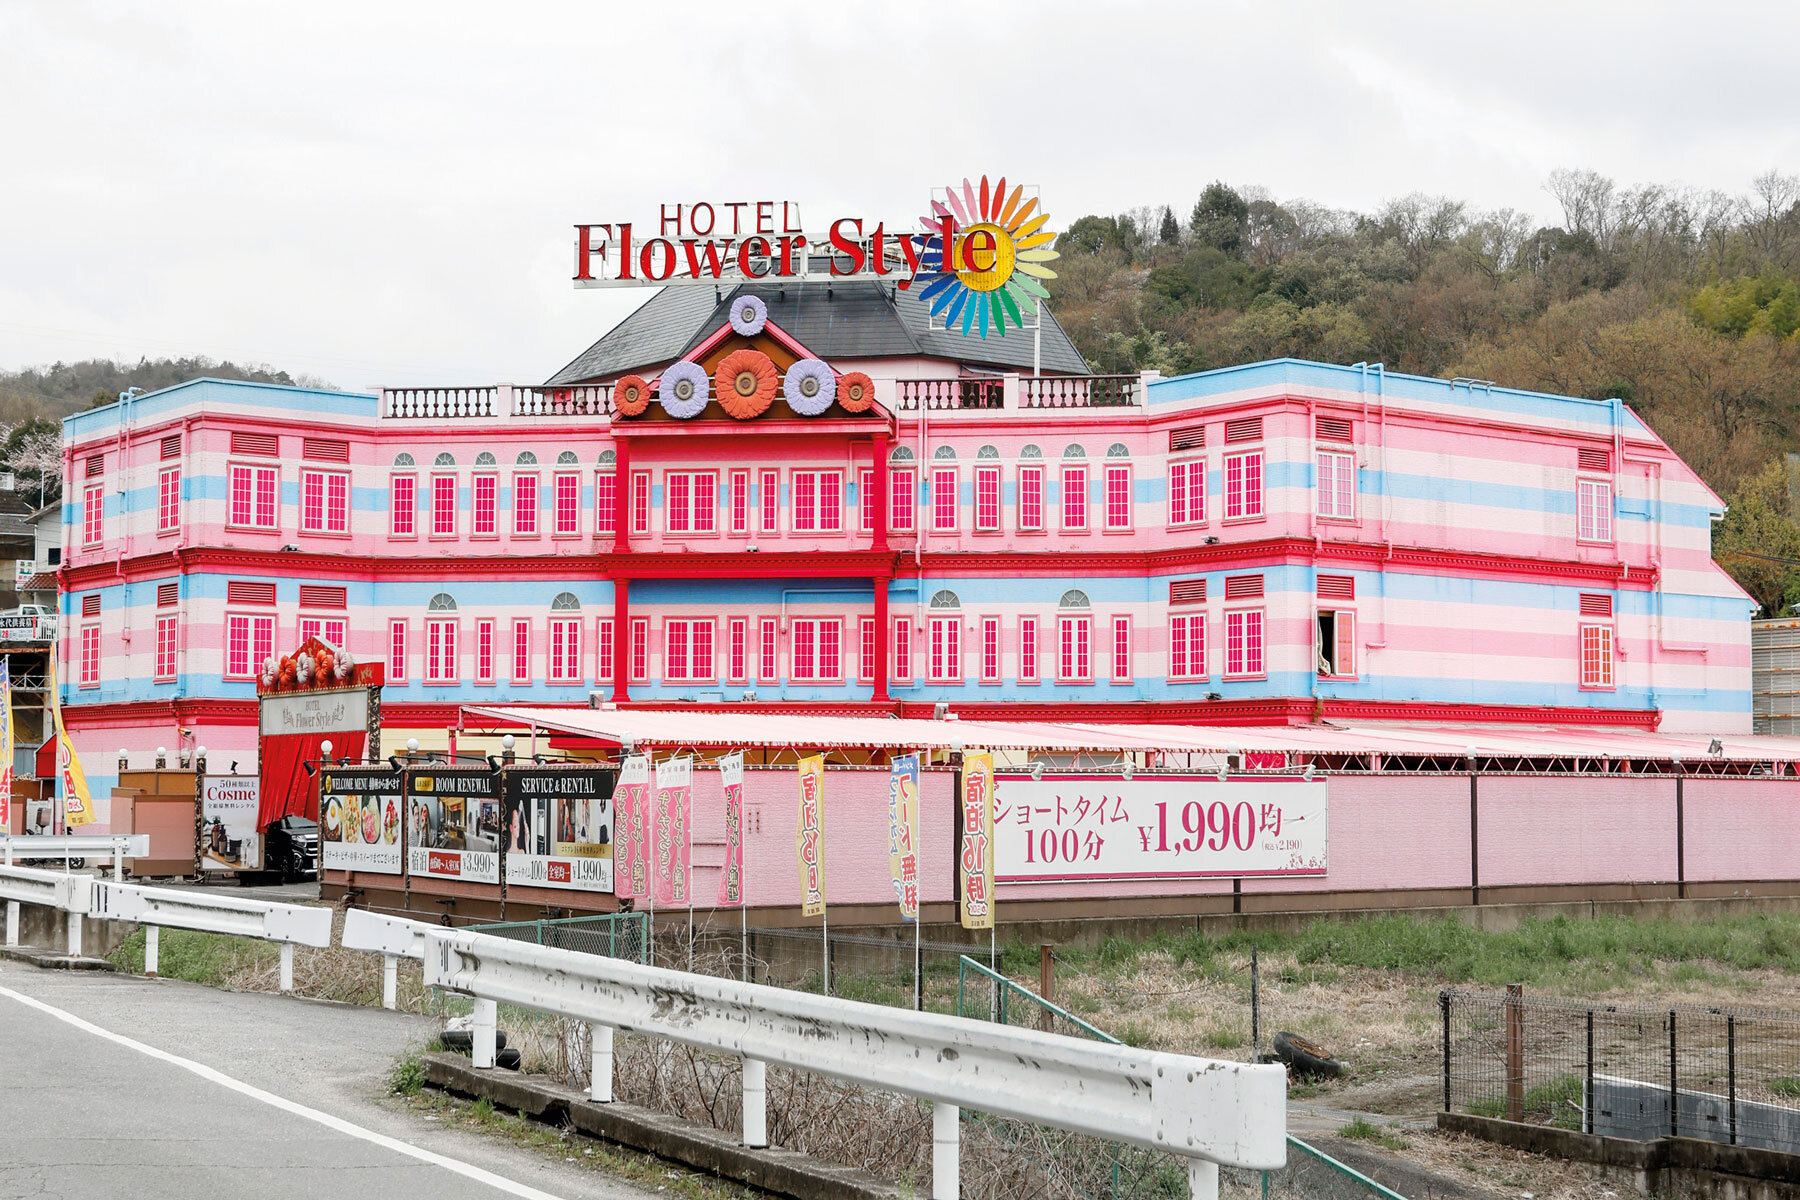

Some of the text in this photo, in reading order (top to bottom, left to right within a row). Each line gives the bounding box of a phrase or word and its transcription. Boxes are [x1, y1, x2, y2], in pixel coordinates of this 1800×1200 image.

[660, 200, 802, 236] HOTEL
[573, 215, 997, 290] Flower Style
[306, 700, 320, 711] HOTEL
[295, 711, 331, 730] Flower Style
[332, 777, 353, 790] WELCOME
[354, 777, 368, 790] MENU
[435, 777, 455, 792] ROOM
[457, 778, 492, 793] RENEWAL
[521, 778, 554, 793] SERVICE
[561, 778, 596, 794] RENTAL
[207, 786, 256, 801] Cosme
[993, 795, 1130, 826] ショートタイム
[1024, 829, 1105, 863] 100分
